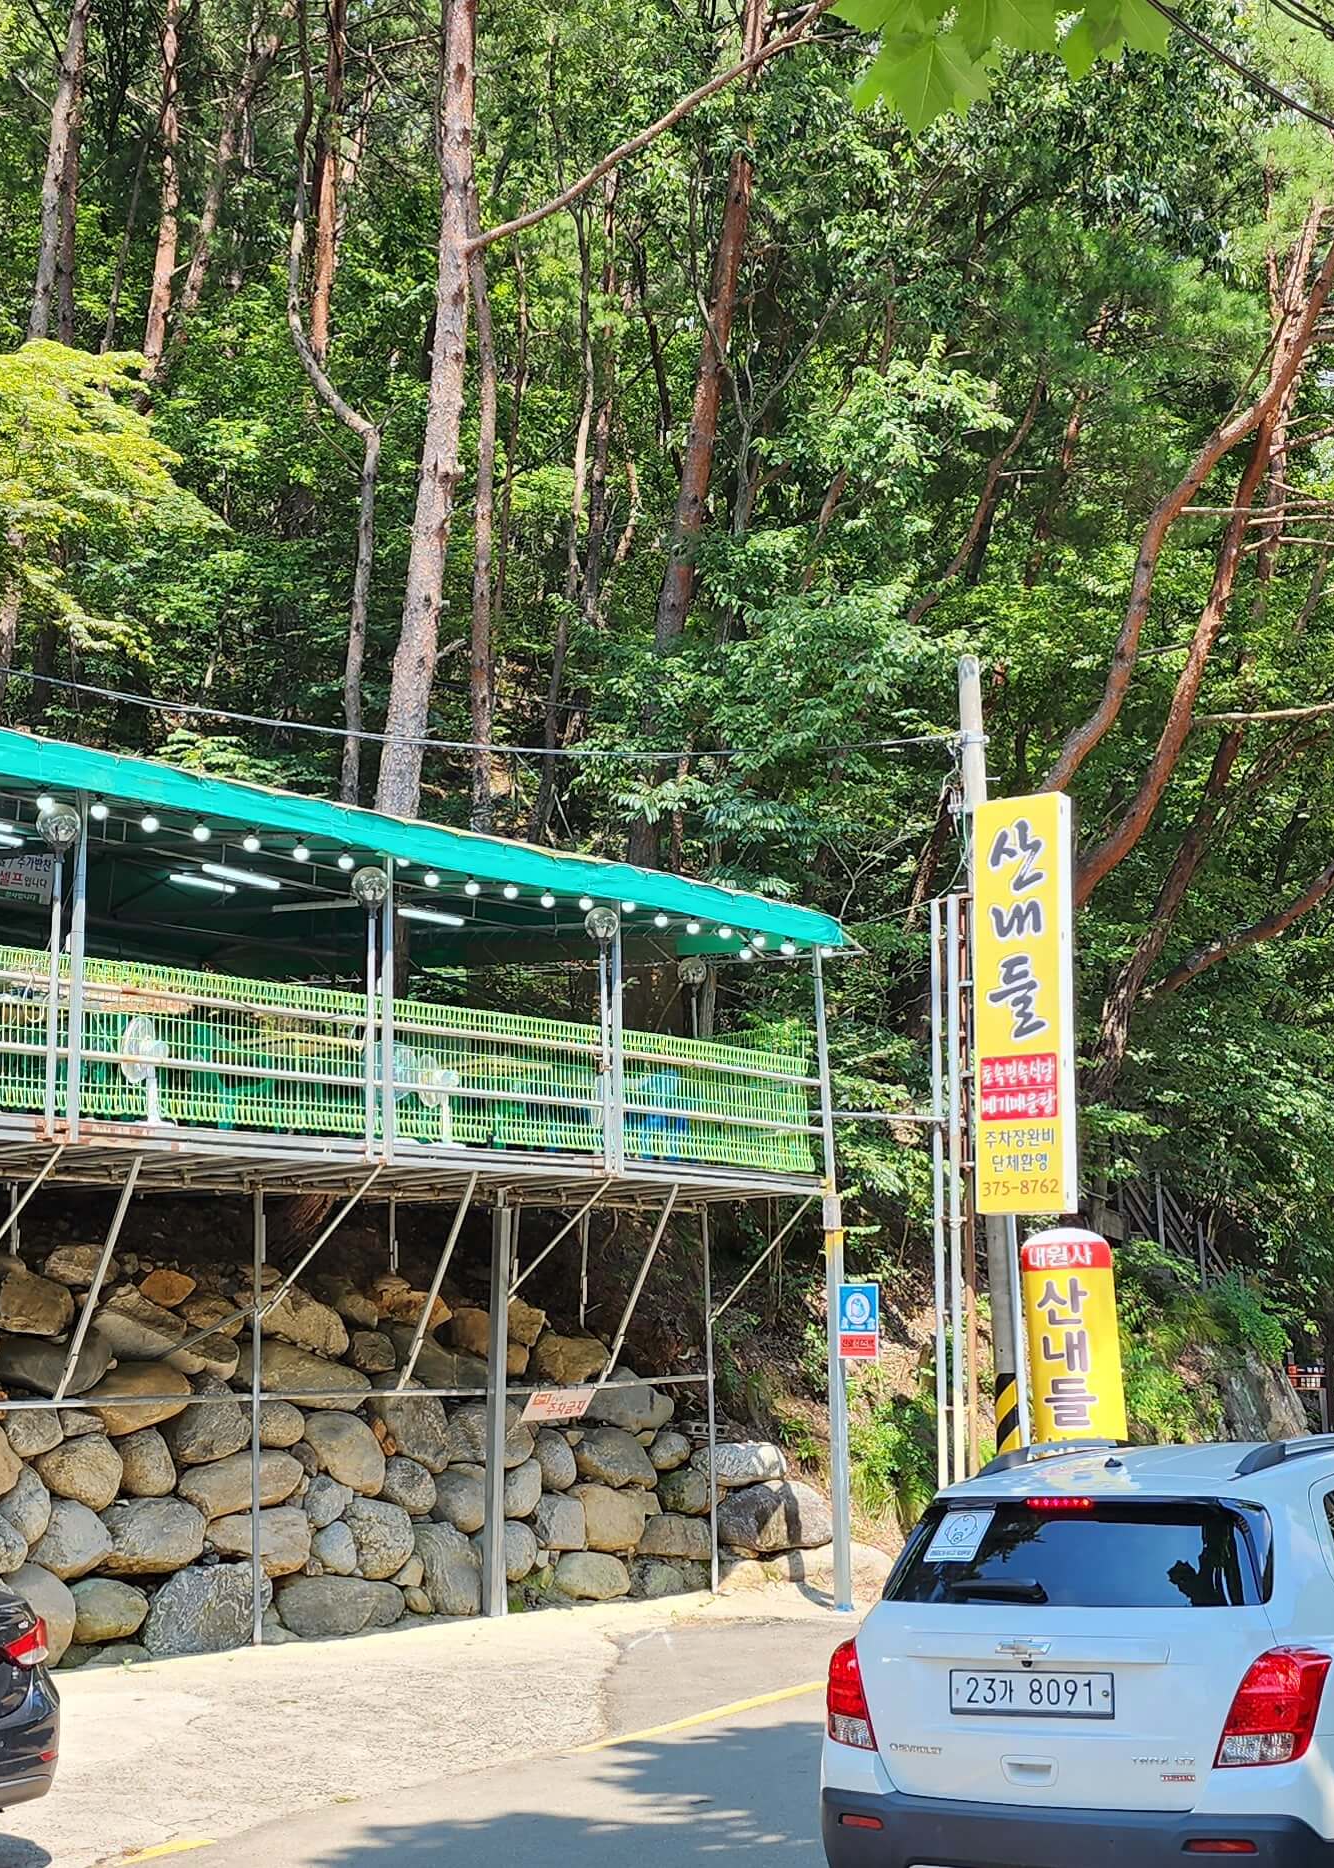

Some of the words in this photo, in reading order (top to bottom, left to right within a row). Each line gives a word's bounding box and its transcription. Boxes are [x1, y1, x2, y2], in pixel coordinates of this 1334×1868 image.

[988, 819, 1047, 1039] 산내들
[982, 1057, 1055, 1086] 토속민속식당
[982, 1089, 1056, 1117] 메기매운탕
[985, 1128, 1055, 1148] 주차장완비
[991, 1153, 1049, 1173] 단체환영
[982, 1179, 1060, 1197] 375-8762
[1028, 1244, 1093, 1269] 내원사
[1036, 1277, 1098, 1428] 산내들
[966, 1677, 1014, 1704] 23가
[1029, 1678, 1093, 1706] 8091
